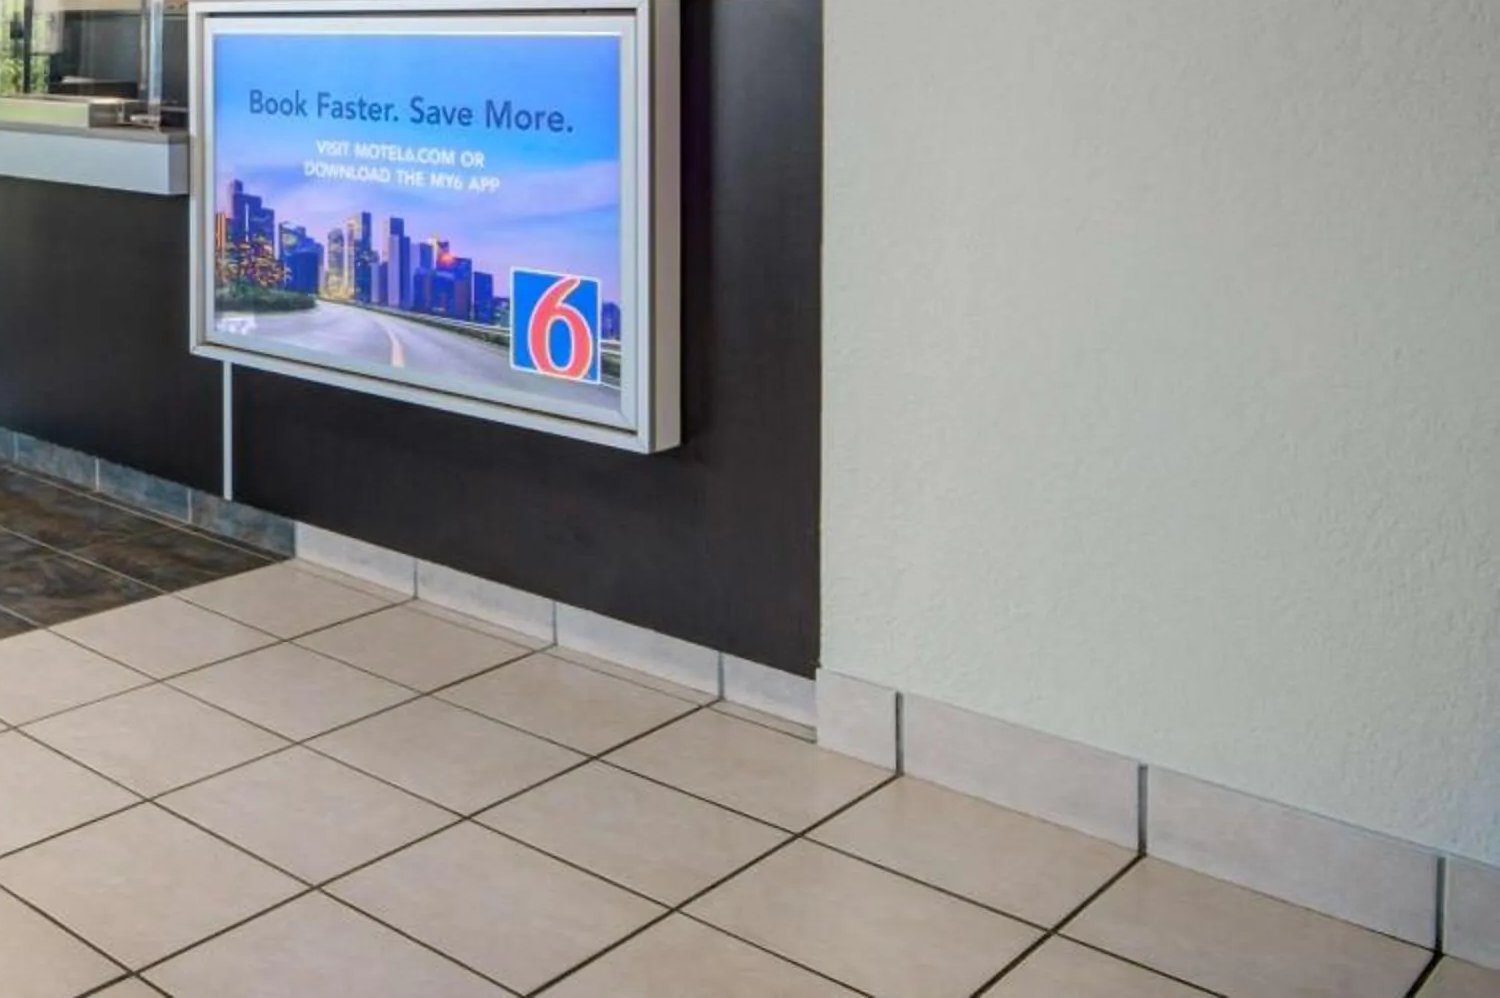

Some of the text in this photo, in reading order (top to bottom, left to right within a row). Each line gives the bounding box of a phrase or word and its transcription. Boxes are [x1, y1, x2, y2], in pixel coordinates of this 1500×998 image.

[249, 89, 575, 134] Book Faster. Save More.
[315, 139, 485, 169] VISIT MOTEL6.COM OR
[303, 160, 501, 194] DOWNLOAD THE MY6 APP
[527, 275, 593, 381] 6
